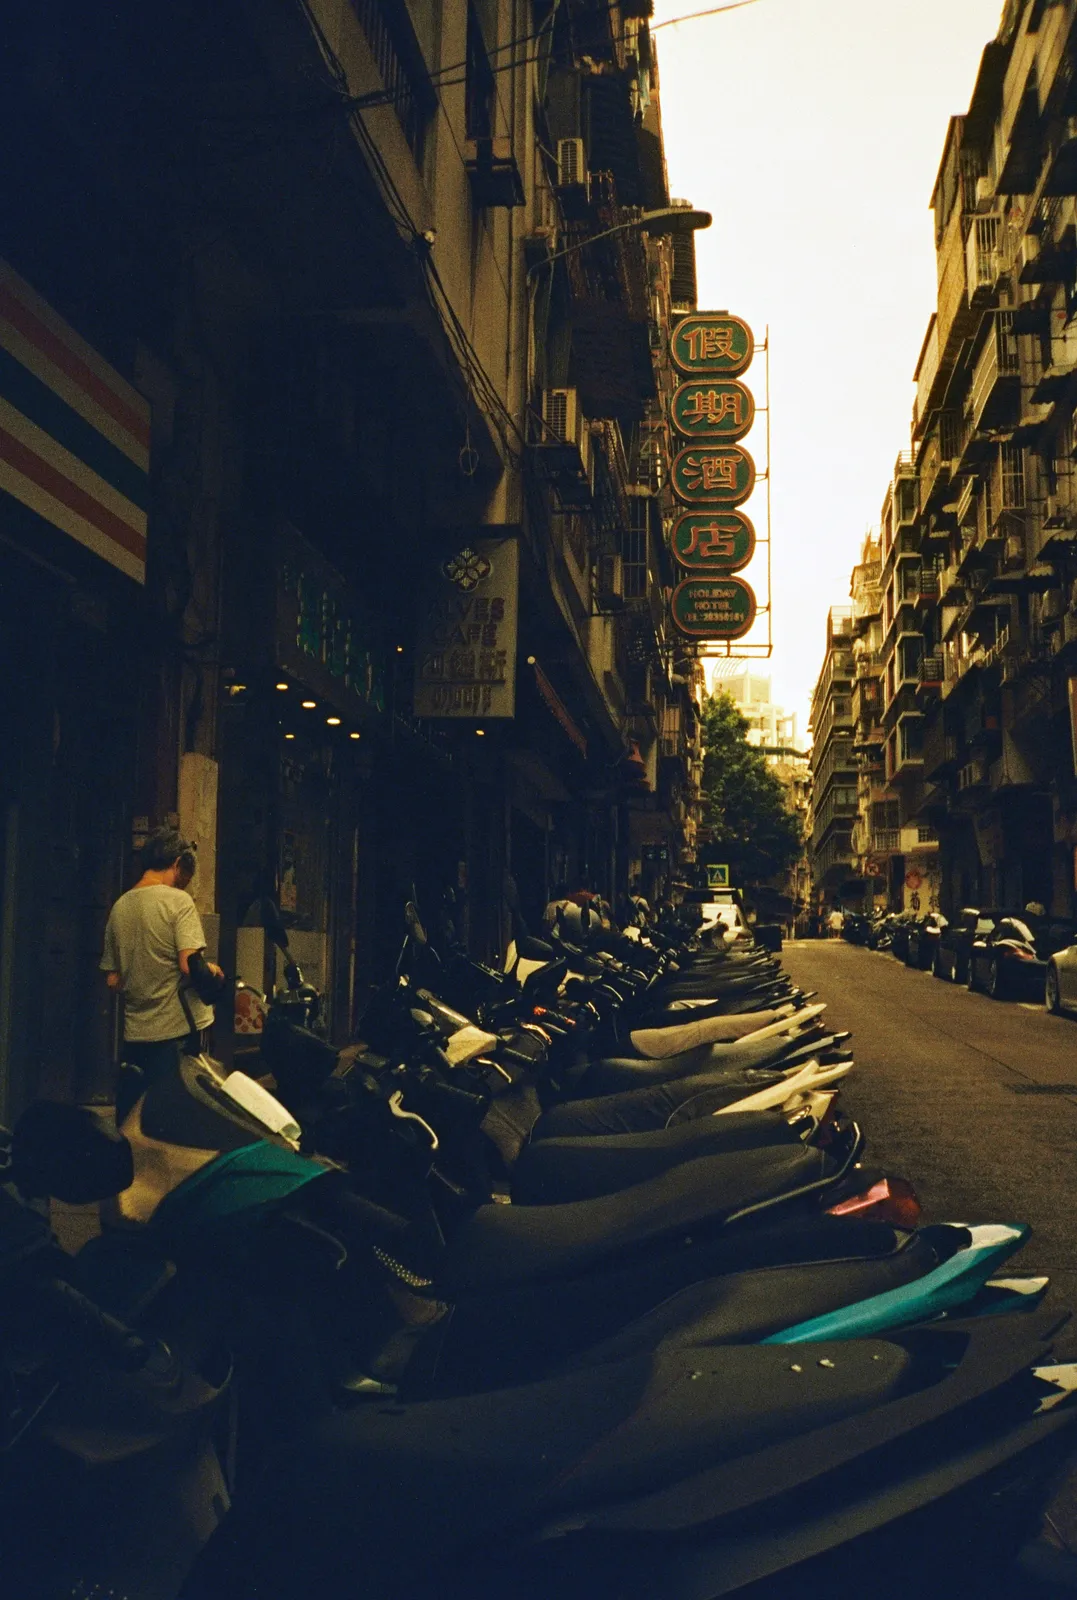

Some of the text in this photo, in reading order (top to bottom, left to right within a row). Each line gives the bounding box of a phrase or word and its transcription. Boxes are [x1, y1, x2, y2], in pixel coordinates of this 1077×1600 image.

[682, 326, 743, 558] 假期酒店
[688, 588, 738, 599] HOLIDAY
[694, 601, 732, 611] HOTEL
